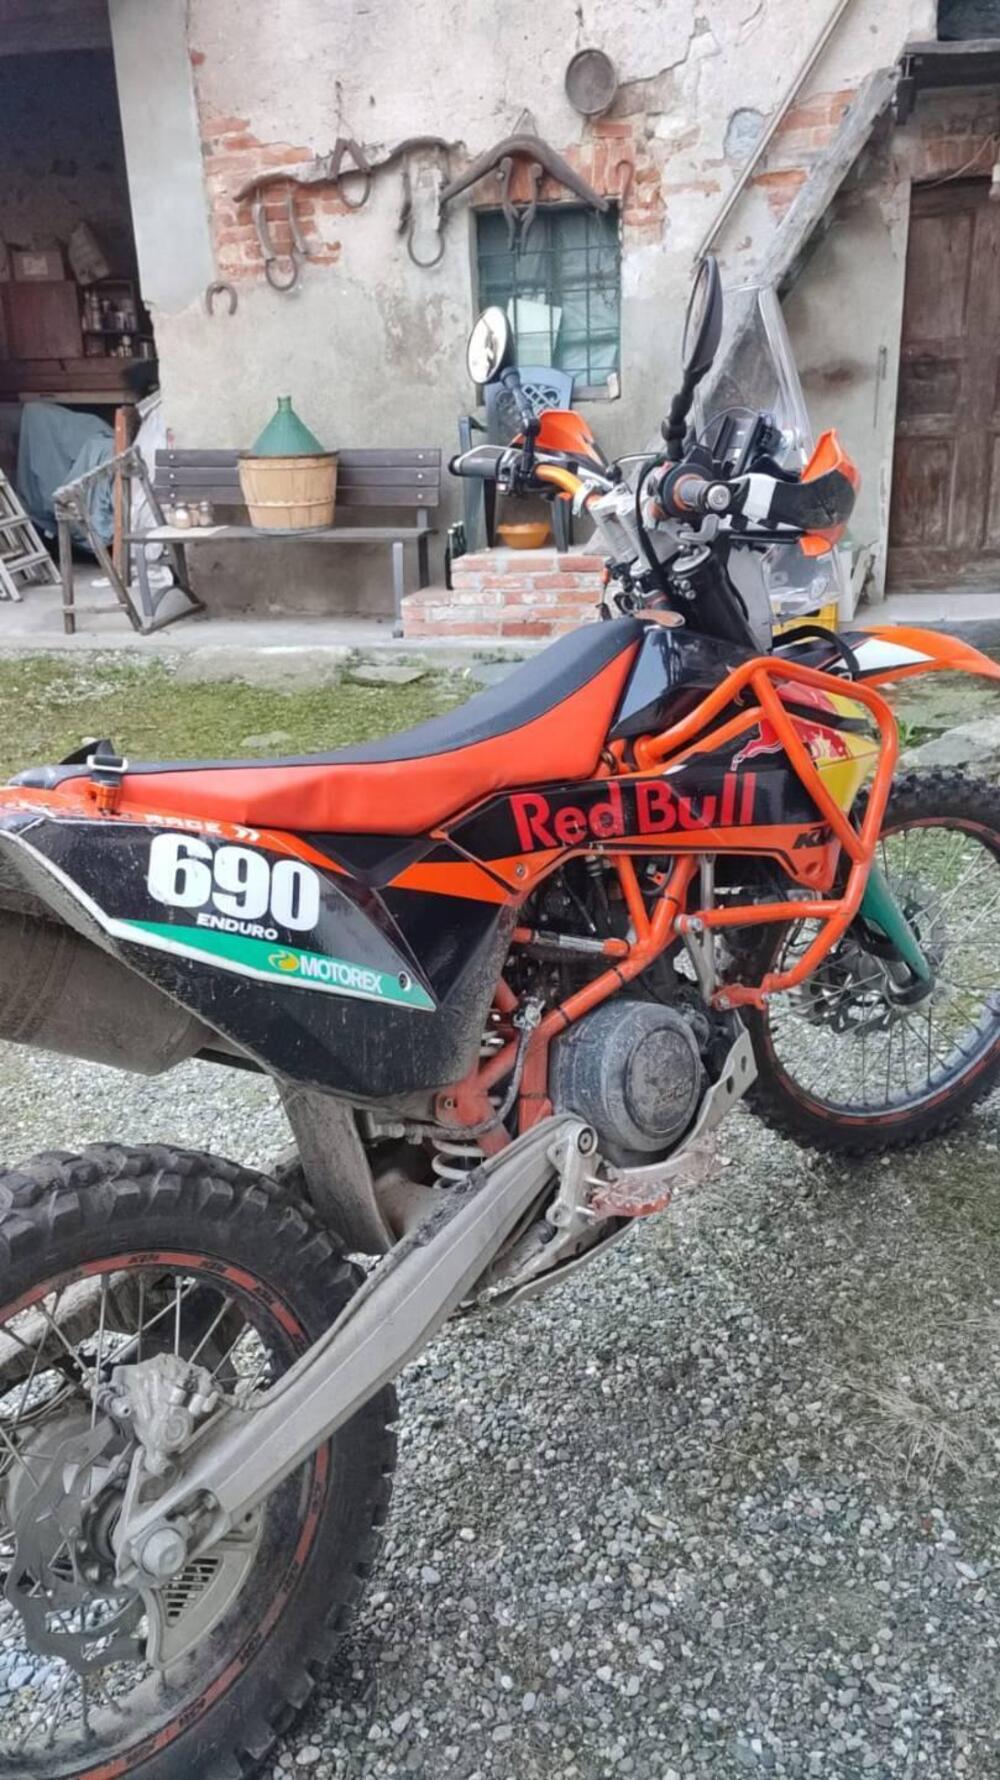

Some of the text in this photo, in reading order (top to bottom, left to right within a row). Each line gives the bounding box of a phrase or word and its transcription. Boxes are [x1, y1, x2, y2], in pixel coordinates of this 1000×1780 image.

[510, 772, 756, 852] Red Bull
[147, 833, 320, 931] 690
[196, 913, 279, 941] ENDURO
[300, 955, 384, 994] MOTOREX
